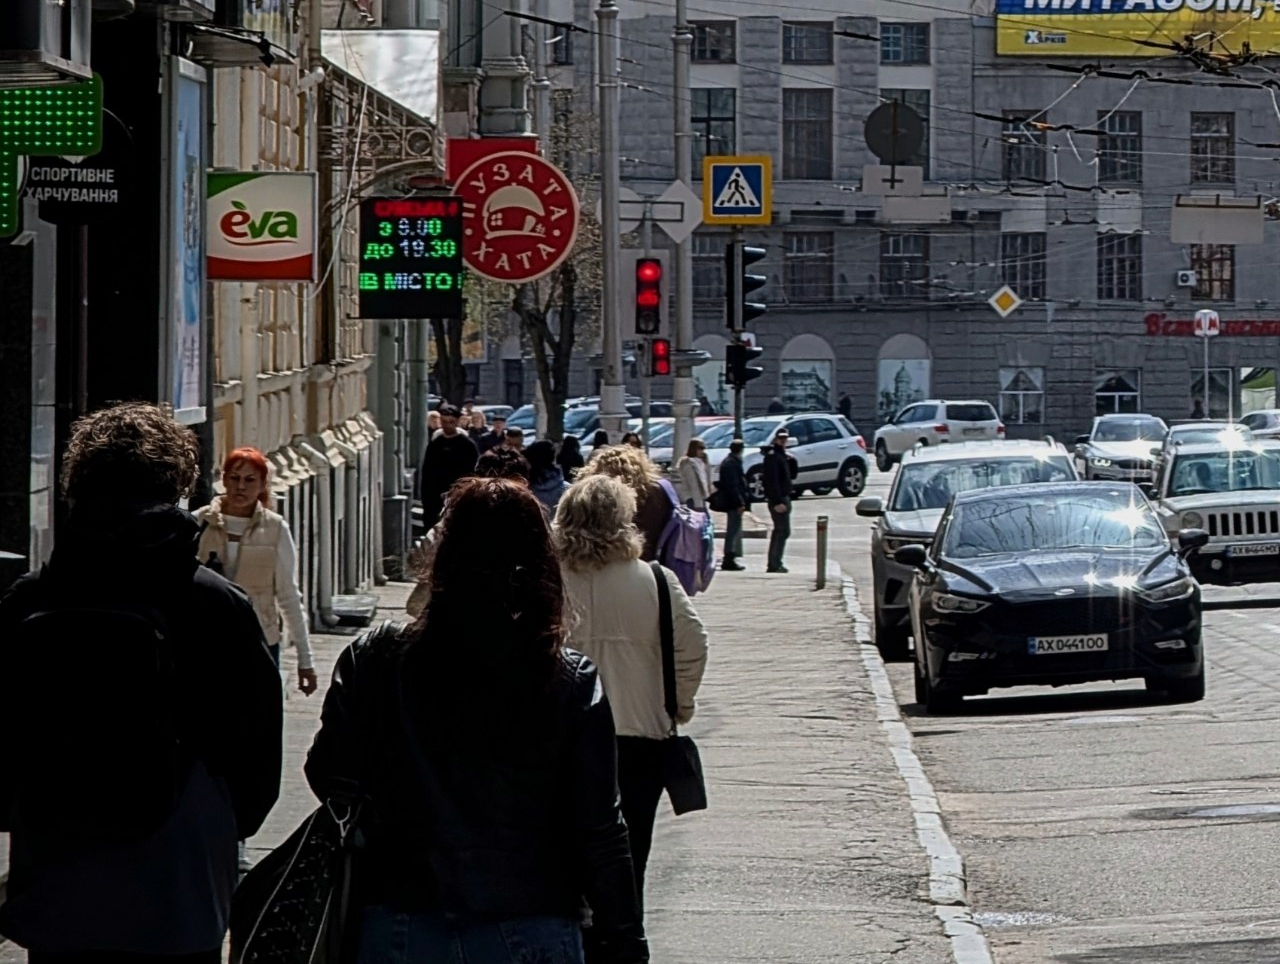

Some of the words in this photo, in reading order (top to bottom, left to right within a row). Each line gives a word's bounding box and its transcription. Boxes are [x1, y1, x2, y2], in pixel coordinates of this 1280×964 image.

[30, 167, 115, 183] СПОРТИВНЕ
[25, 187, 119, 203] ХАРЧУВАННЯ
[398, 218, 442, 236] 9.00
[364, 243, 394, 260] до
[399, 239, 456, 257] 19.30
[472, 241, 557, 272] ХАТА
